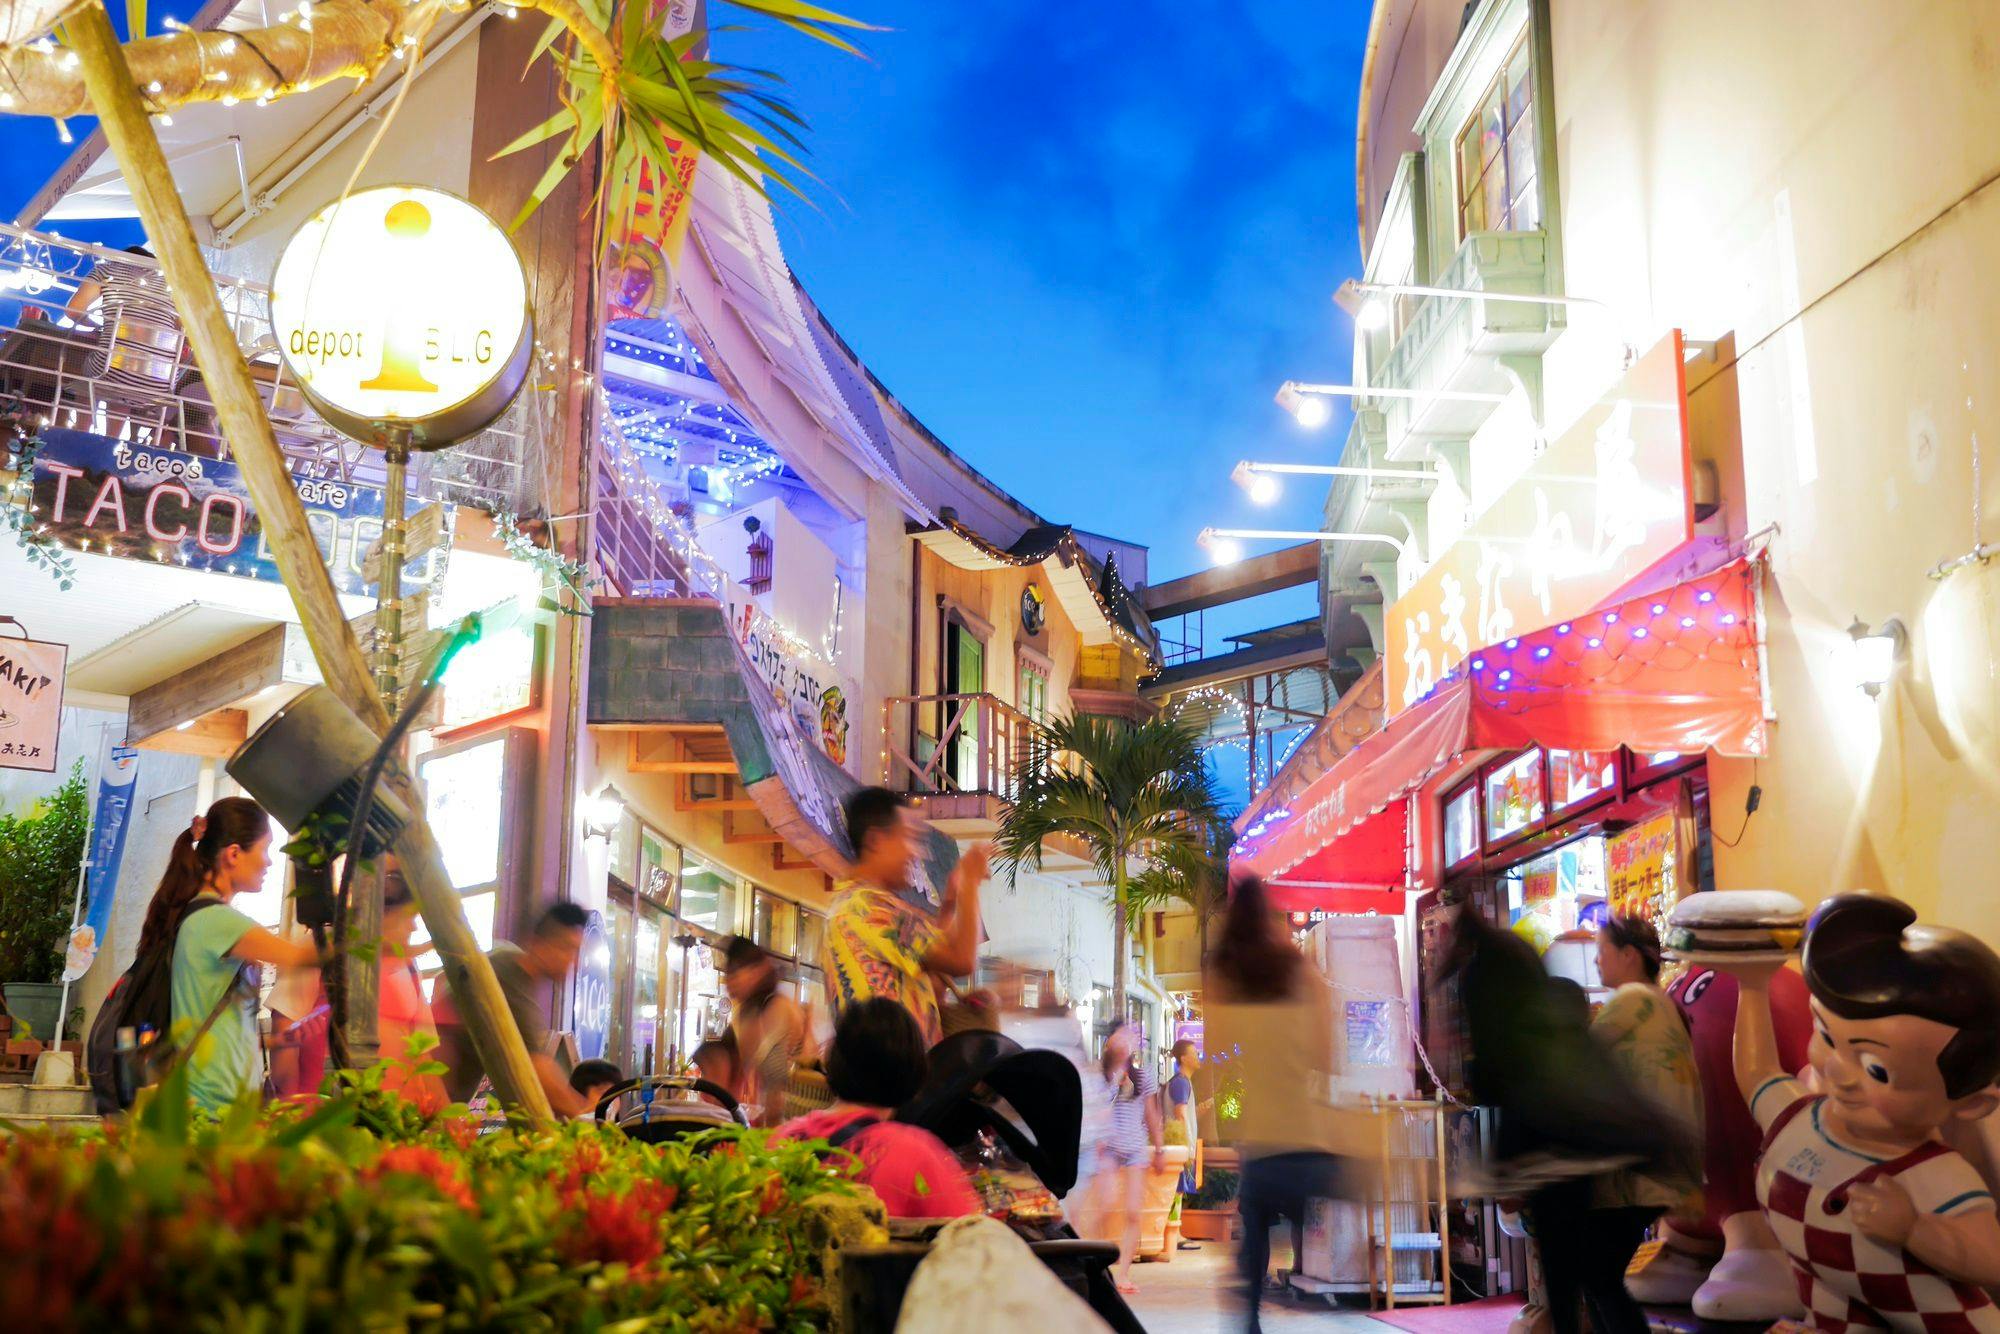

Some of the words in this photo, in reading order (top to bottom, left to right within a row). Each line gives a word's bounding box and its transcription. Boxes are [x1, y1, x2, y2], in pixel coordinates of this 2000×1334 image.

[291, 330, 363, 366] depot
[118, 446, 202, 480] tacos
[300, 483, 346, 507] afe
[46, 462, 246, 554] TACO
